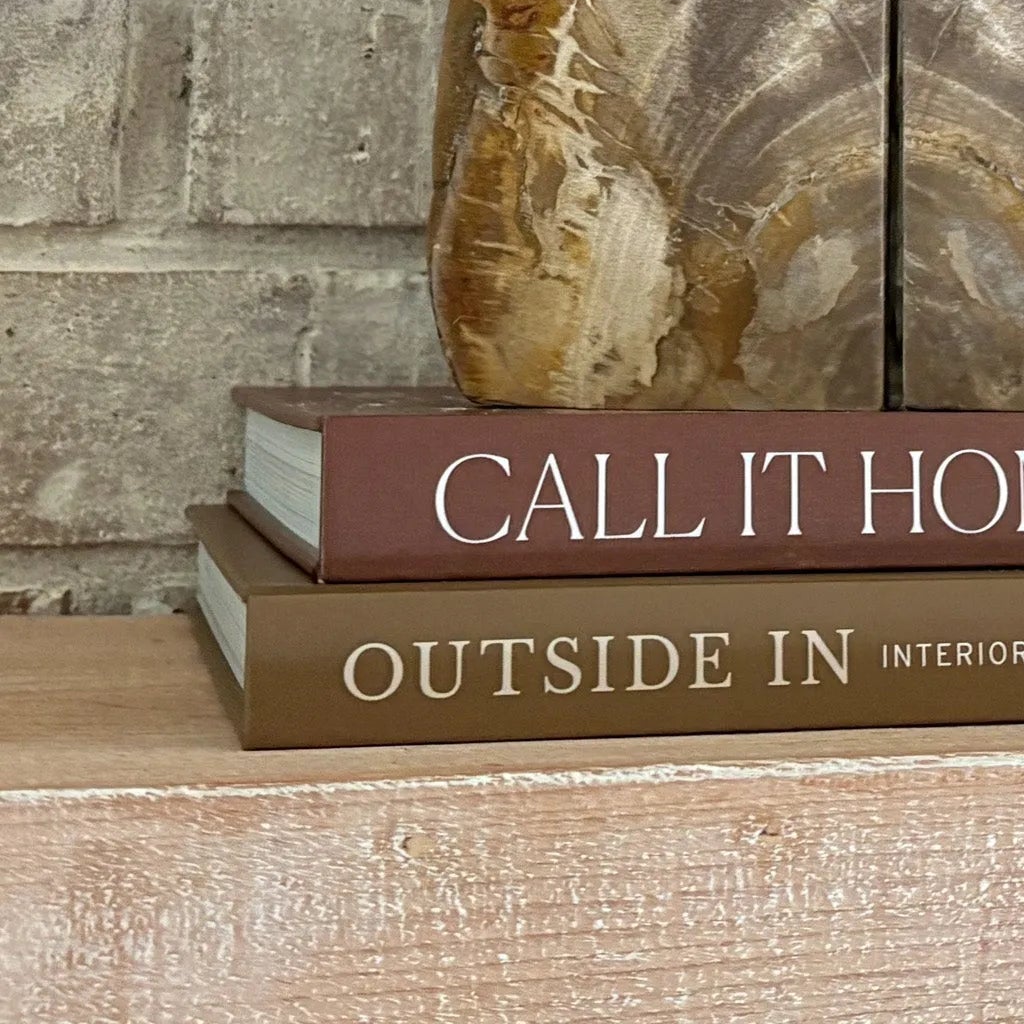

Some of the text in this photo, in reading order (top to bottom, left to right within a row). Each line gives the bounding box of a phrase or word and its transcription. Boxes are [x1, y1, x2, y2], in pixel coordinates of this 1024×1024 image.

[434, 452, 706, 544] CALL
[740, 451, 827, 537] IT
[343, 628, 855, 701] OUTSIDE IN
